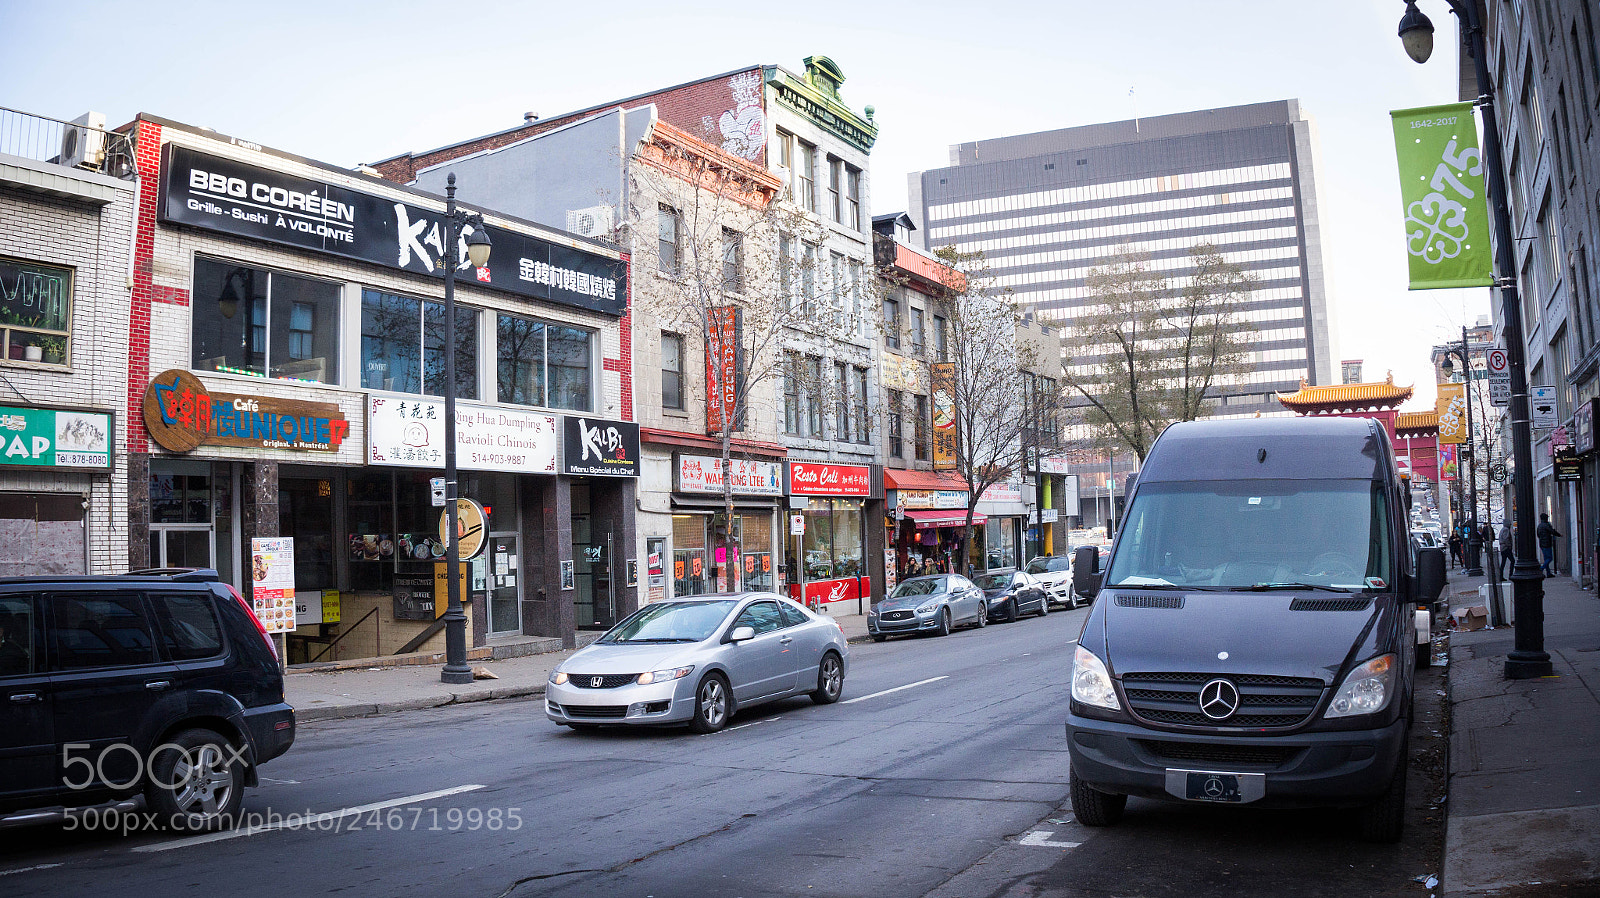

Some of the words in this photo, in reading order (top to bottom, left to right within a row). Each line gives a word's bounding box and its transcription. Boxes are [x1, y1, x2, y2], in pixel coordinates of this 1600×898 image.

[1410, 117, 1458, 129] 1642-2017
[189, 169, 248, 198] BBQ
[251, 183, 355, 222] CORÉEN
[187, 198, 222, 215] Grille
[232, 208, 269, 225] Sushi
[275, 214, 287, 228] À
[288, 219, 354, 243] VOLONTÉ
[234, 398, 259, 412] Café
[396, 401, 437, 420] 青花苑
[477, 412, 496, 425] Hua
[499, 414, 541, 433] Dumpling
[458, 431, 493, 446] Ravioli
[497, 434, 537, 449] Chinois
[472, 453, 526, 465] 514-903-9887
[570, 465, 589, 473] Menu
[620, 468, 635, 476] Chef
[794, 465, 818, 483] Resto
